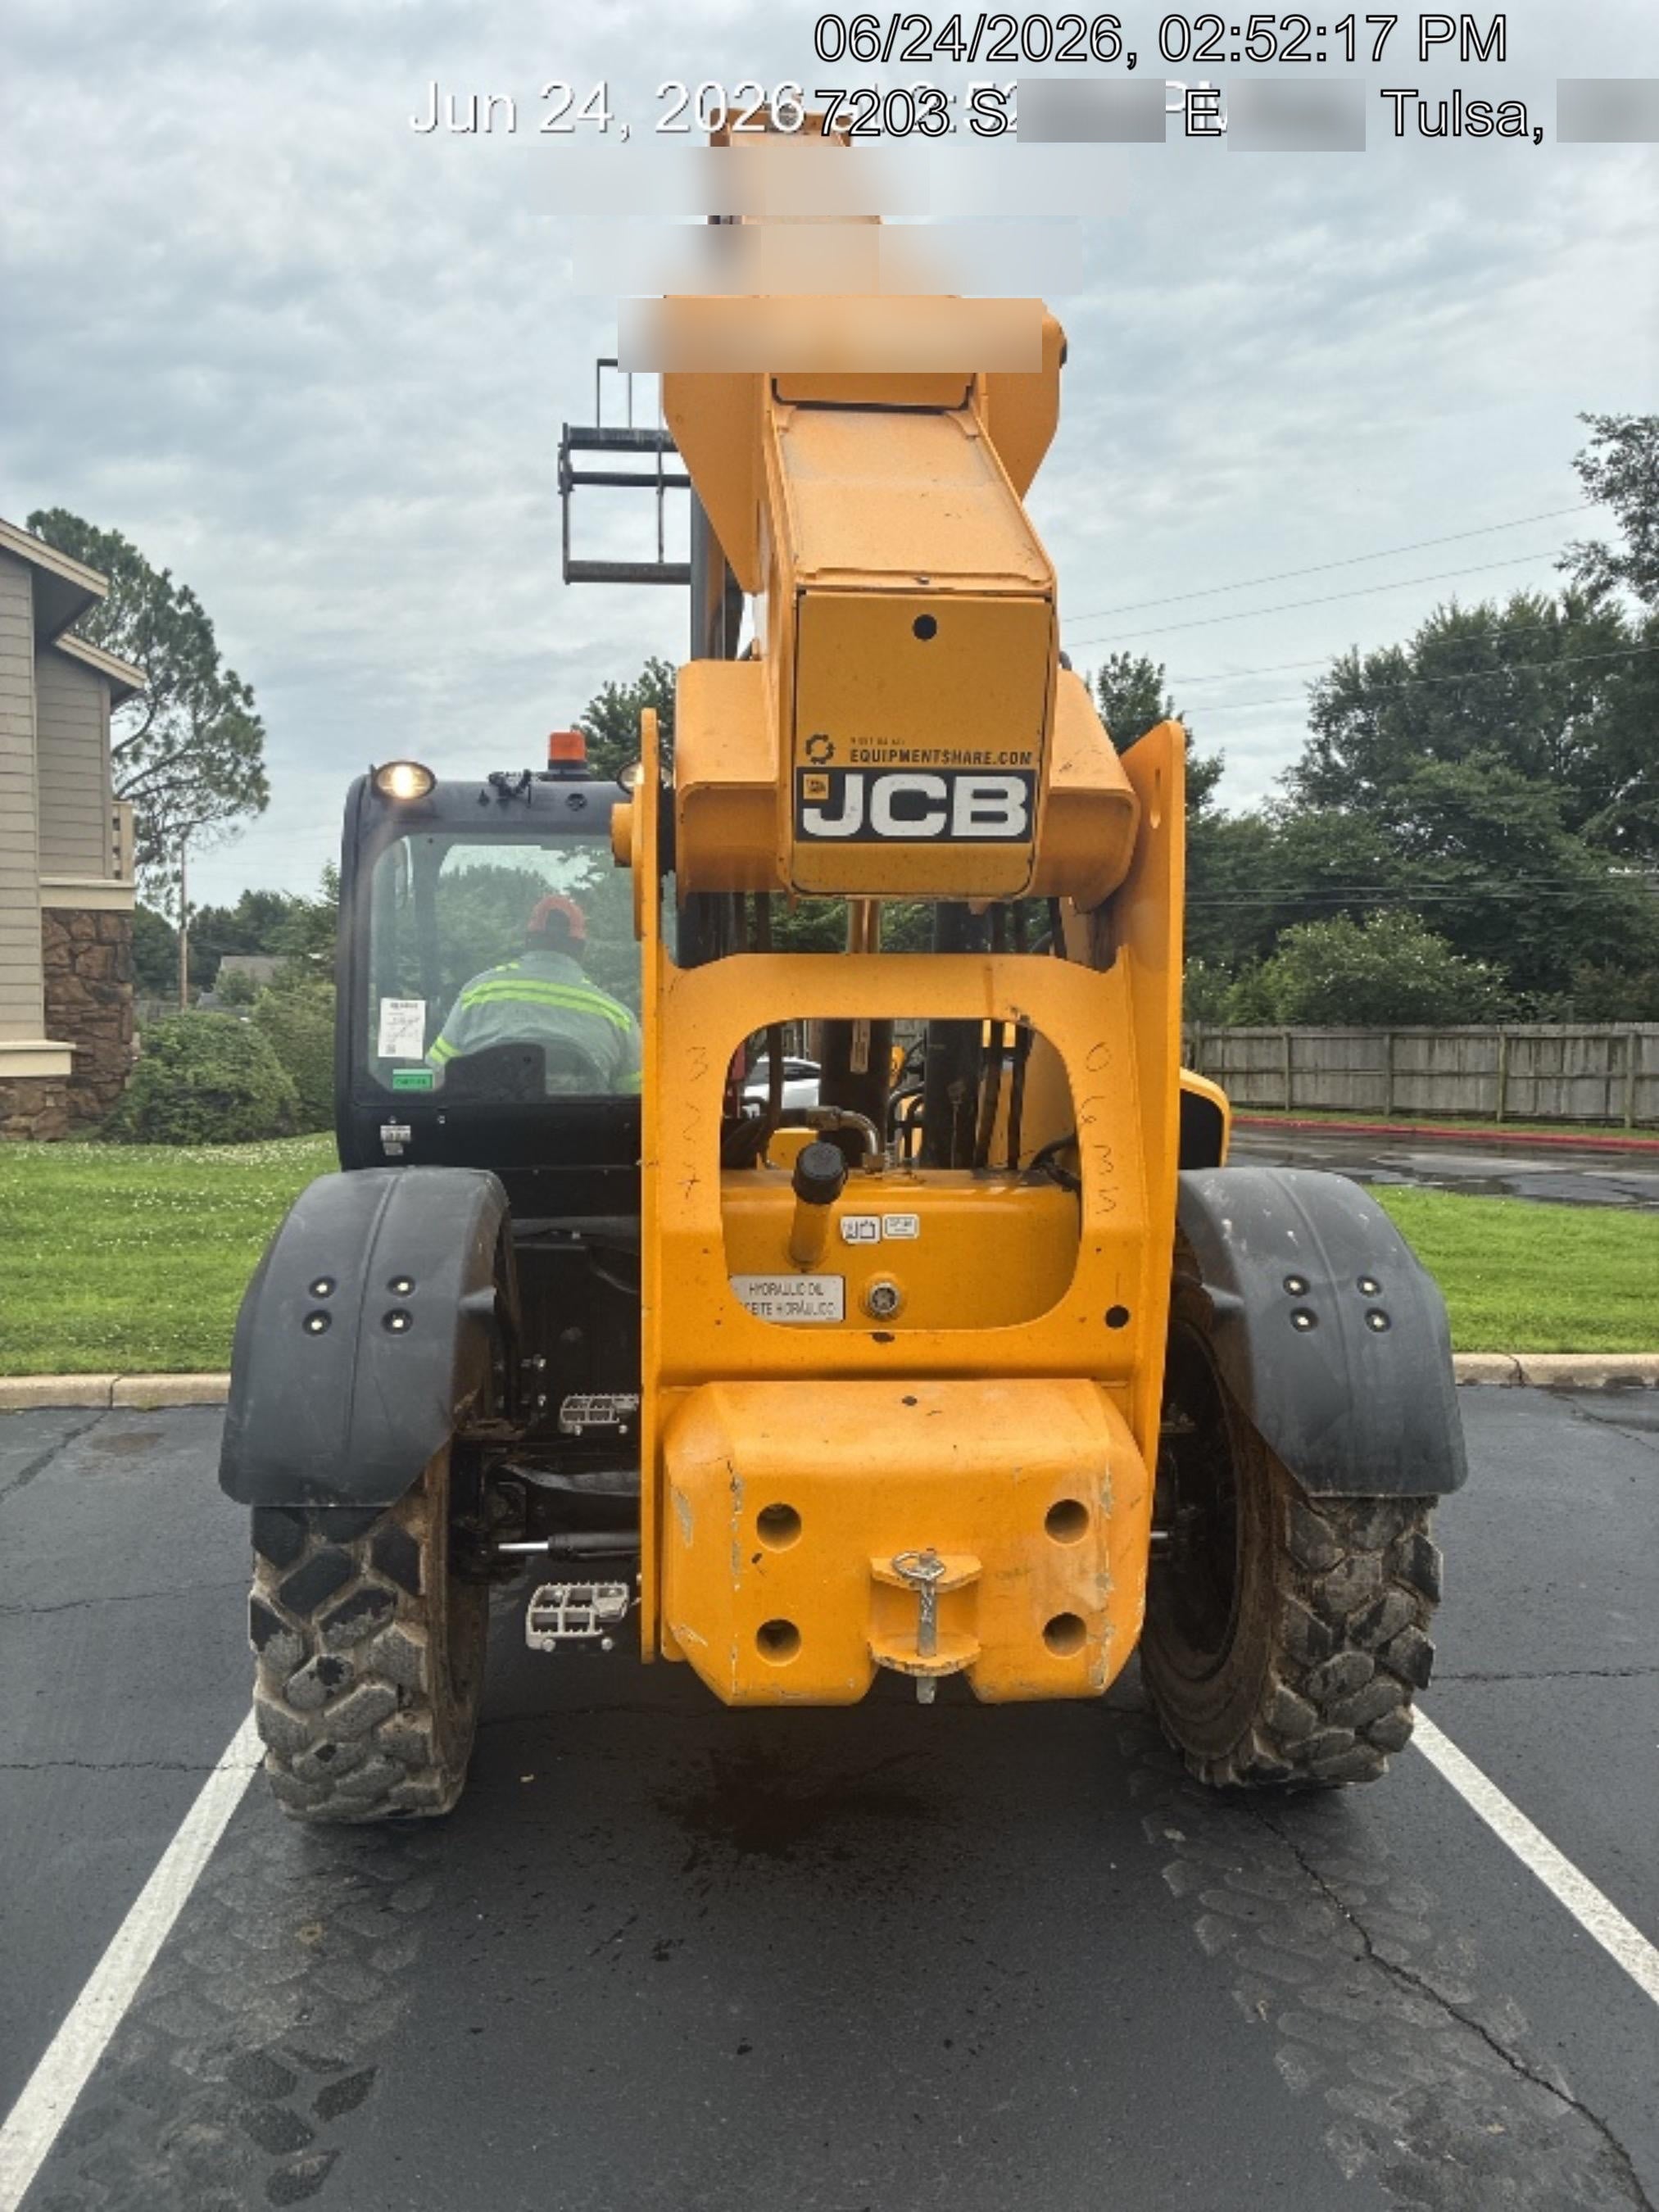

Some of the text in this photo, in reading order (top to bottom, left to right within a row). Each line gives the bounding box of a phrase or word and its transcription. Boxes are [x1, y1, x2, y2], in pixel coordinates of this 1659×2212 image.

[850, 748, 1033, 765] EQUIPMENTSHARE.COM
[802, 773, 1028, 837] JCB
[749, 1282, 805, 1296] HYDRAULIC
